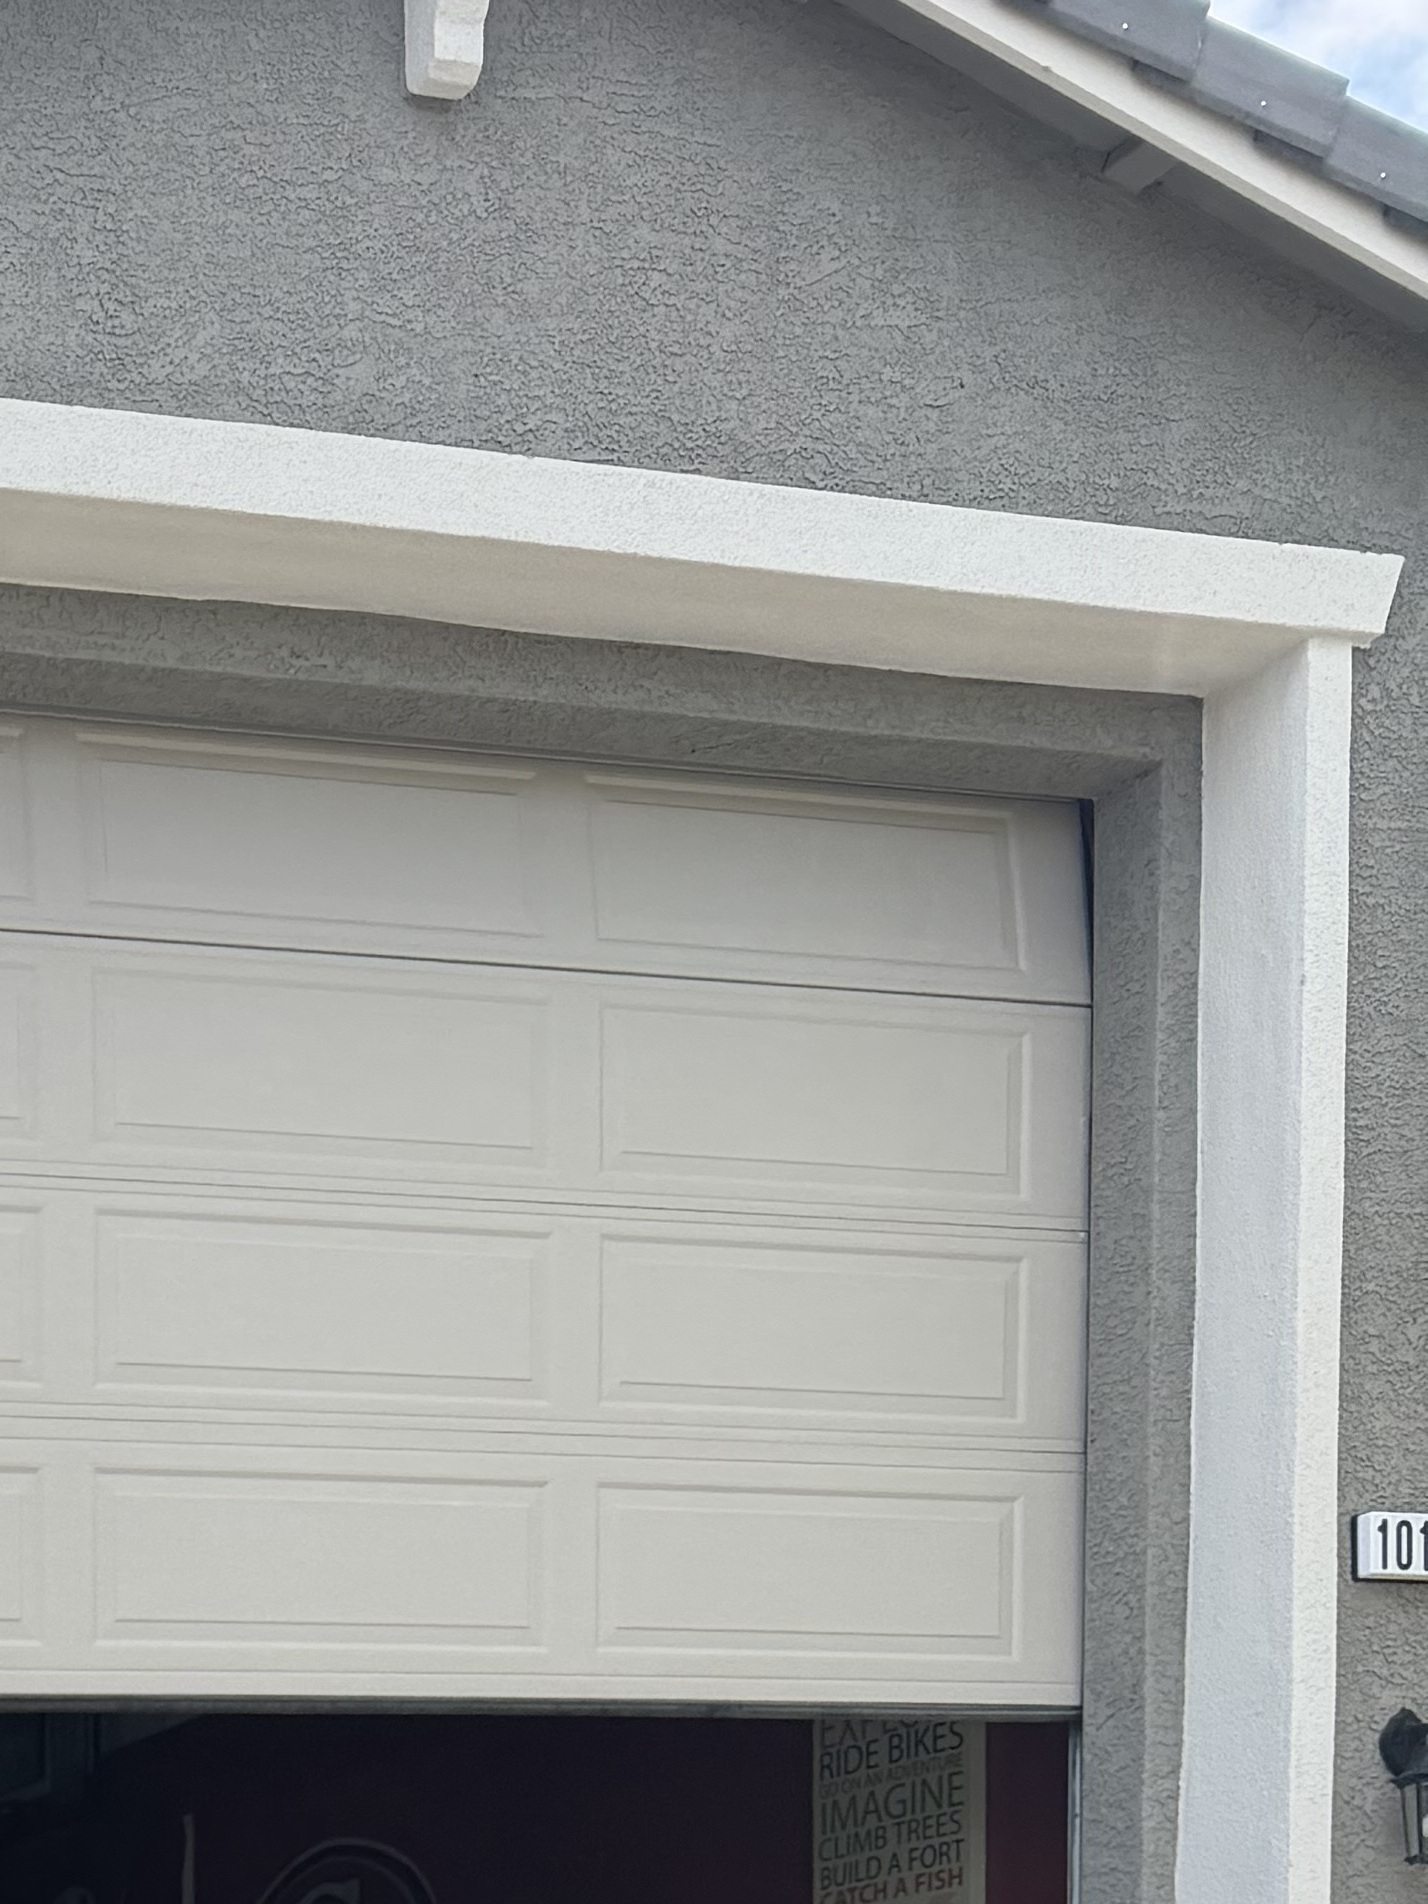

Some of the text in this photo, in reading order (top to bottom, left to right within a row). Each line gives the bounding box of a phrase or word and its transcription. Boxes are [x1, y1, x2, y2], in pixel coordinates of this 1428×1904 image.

[1376, 1518, 1428, 1572] 101
[819, 1739, 880, 1782] RIDE
[888, 1721, 964, 1764] BIKES
[819, 1752, 963, 1799] GO ON AN ADVENTURE
[821, 1771, 965, 1835] IMAGINE
[818, 1810, 962, 1862] CLIMB TREES
[820, 1839, 965, 1890] BUILD A FORT
[894, 1877, 908, 1897] A
[915, 1867, 964, 1893] FISH
